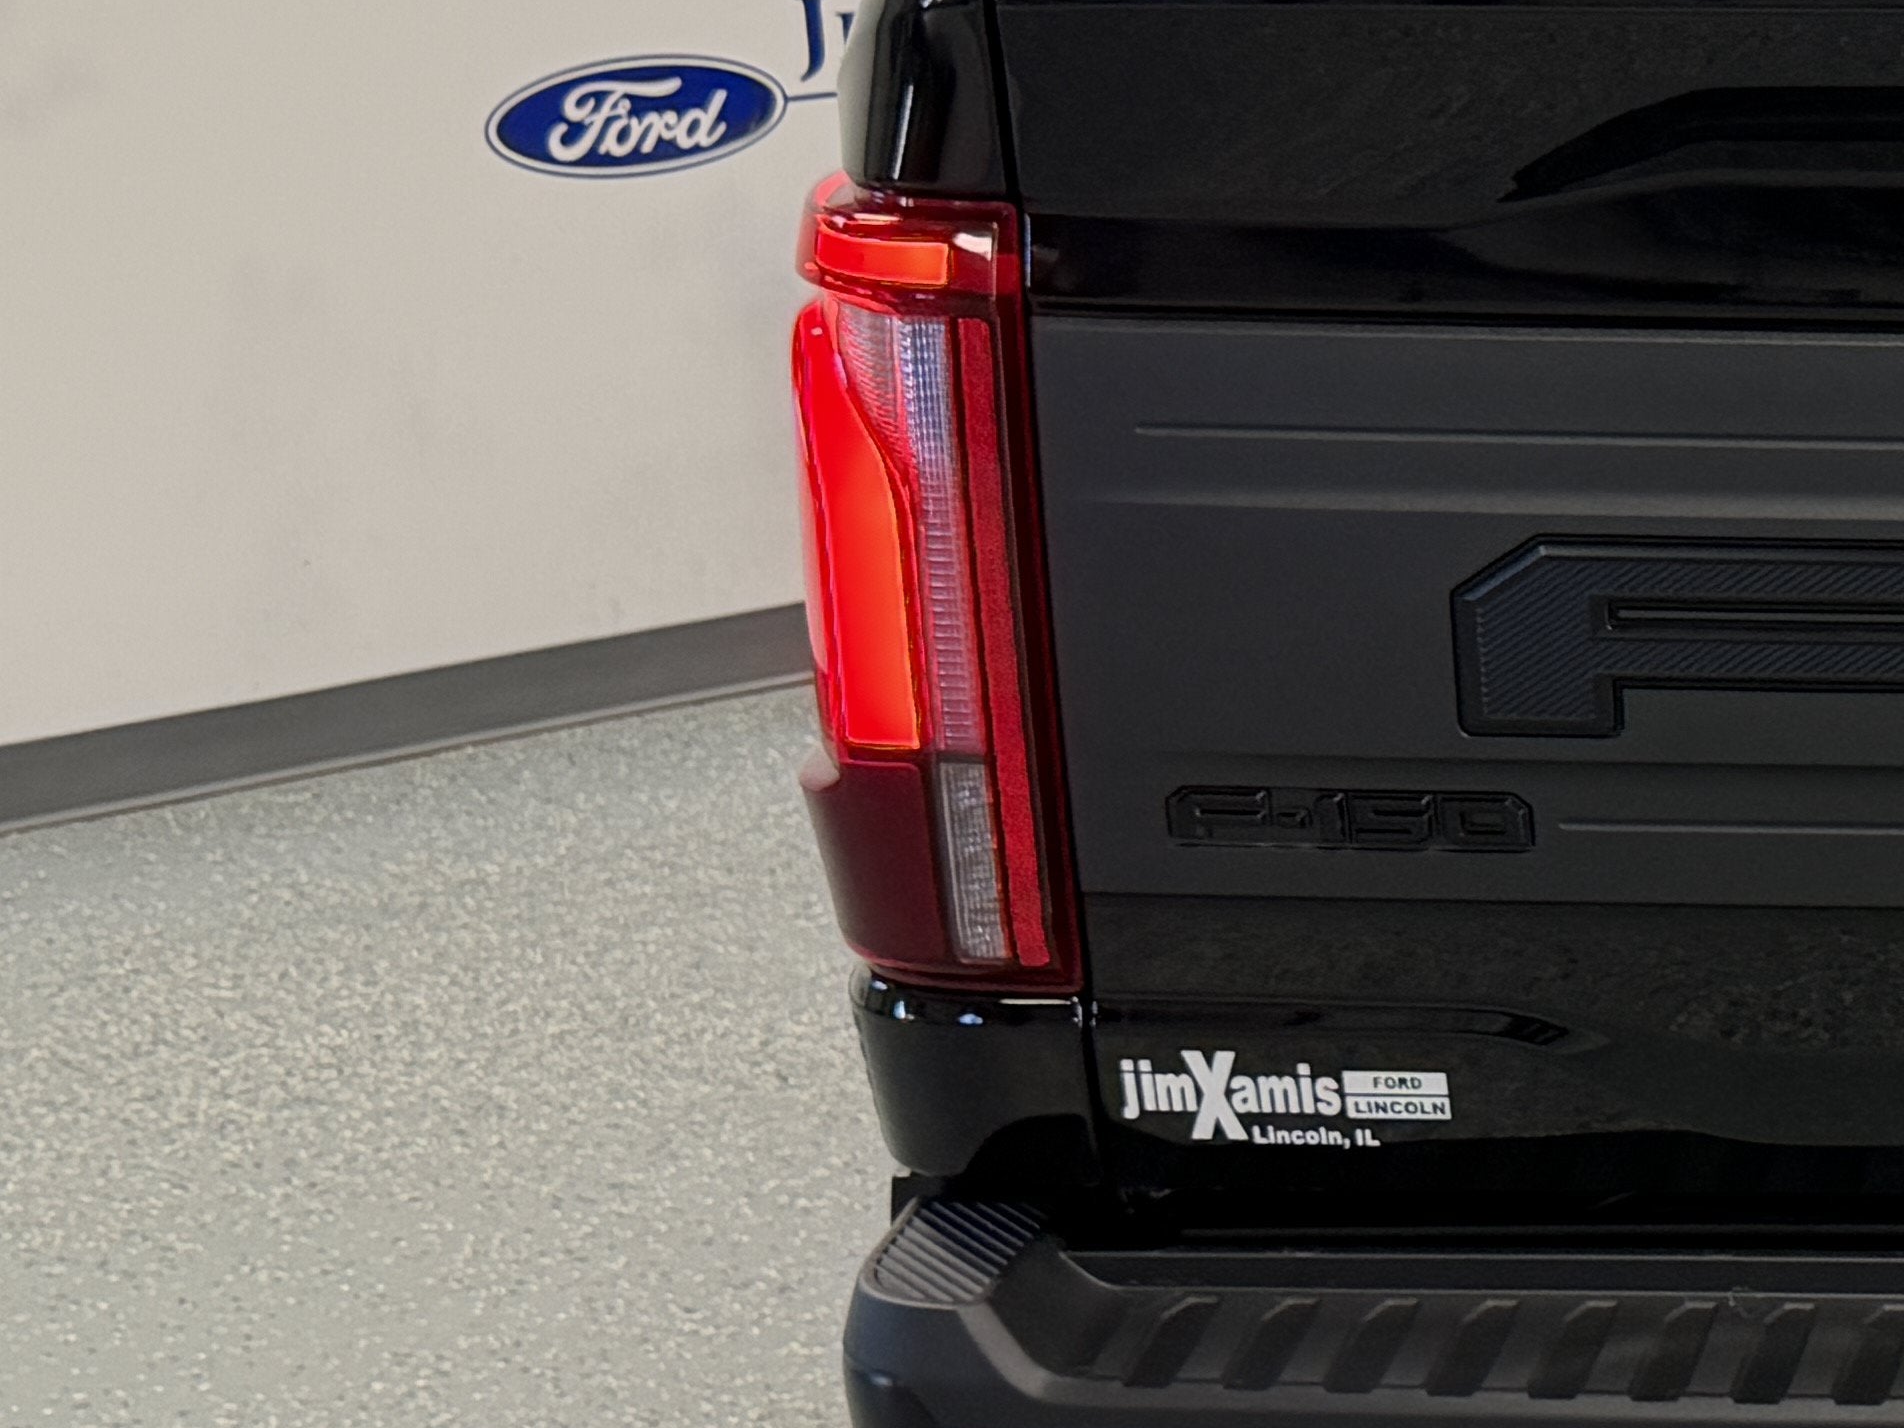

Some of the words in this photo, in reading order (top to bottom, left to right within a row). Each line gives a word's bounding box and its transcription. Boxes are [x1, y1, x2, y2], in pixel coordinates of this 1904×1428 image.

[547, 75, 728, 163] Ford
[1166, 784, 1536, 854] F-150
[1372, 1076, 1423, 1090] FORD
[1353, 1100, 1446, 1116] LINCOLN
[1251, 1125, 1351, 1150] Lincoln,
[1354, 1128, 1381, 1147] IL
